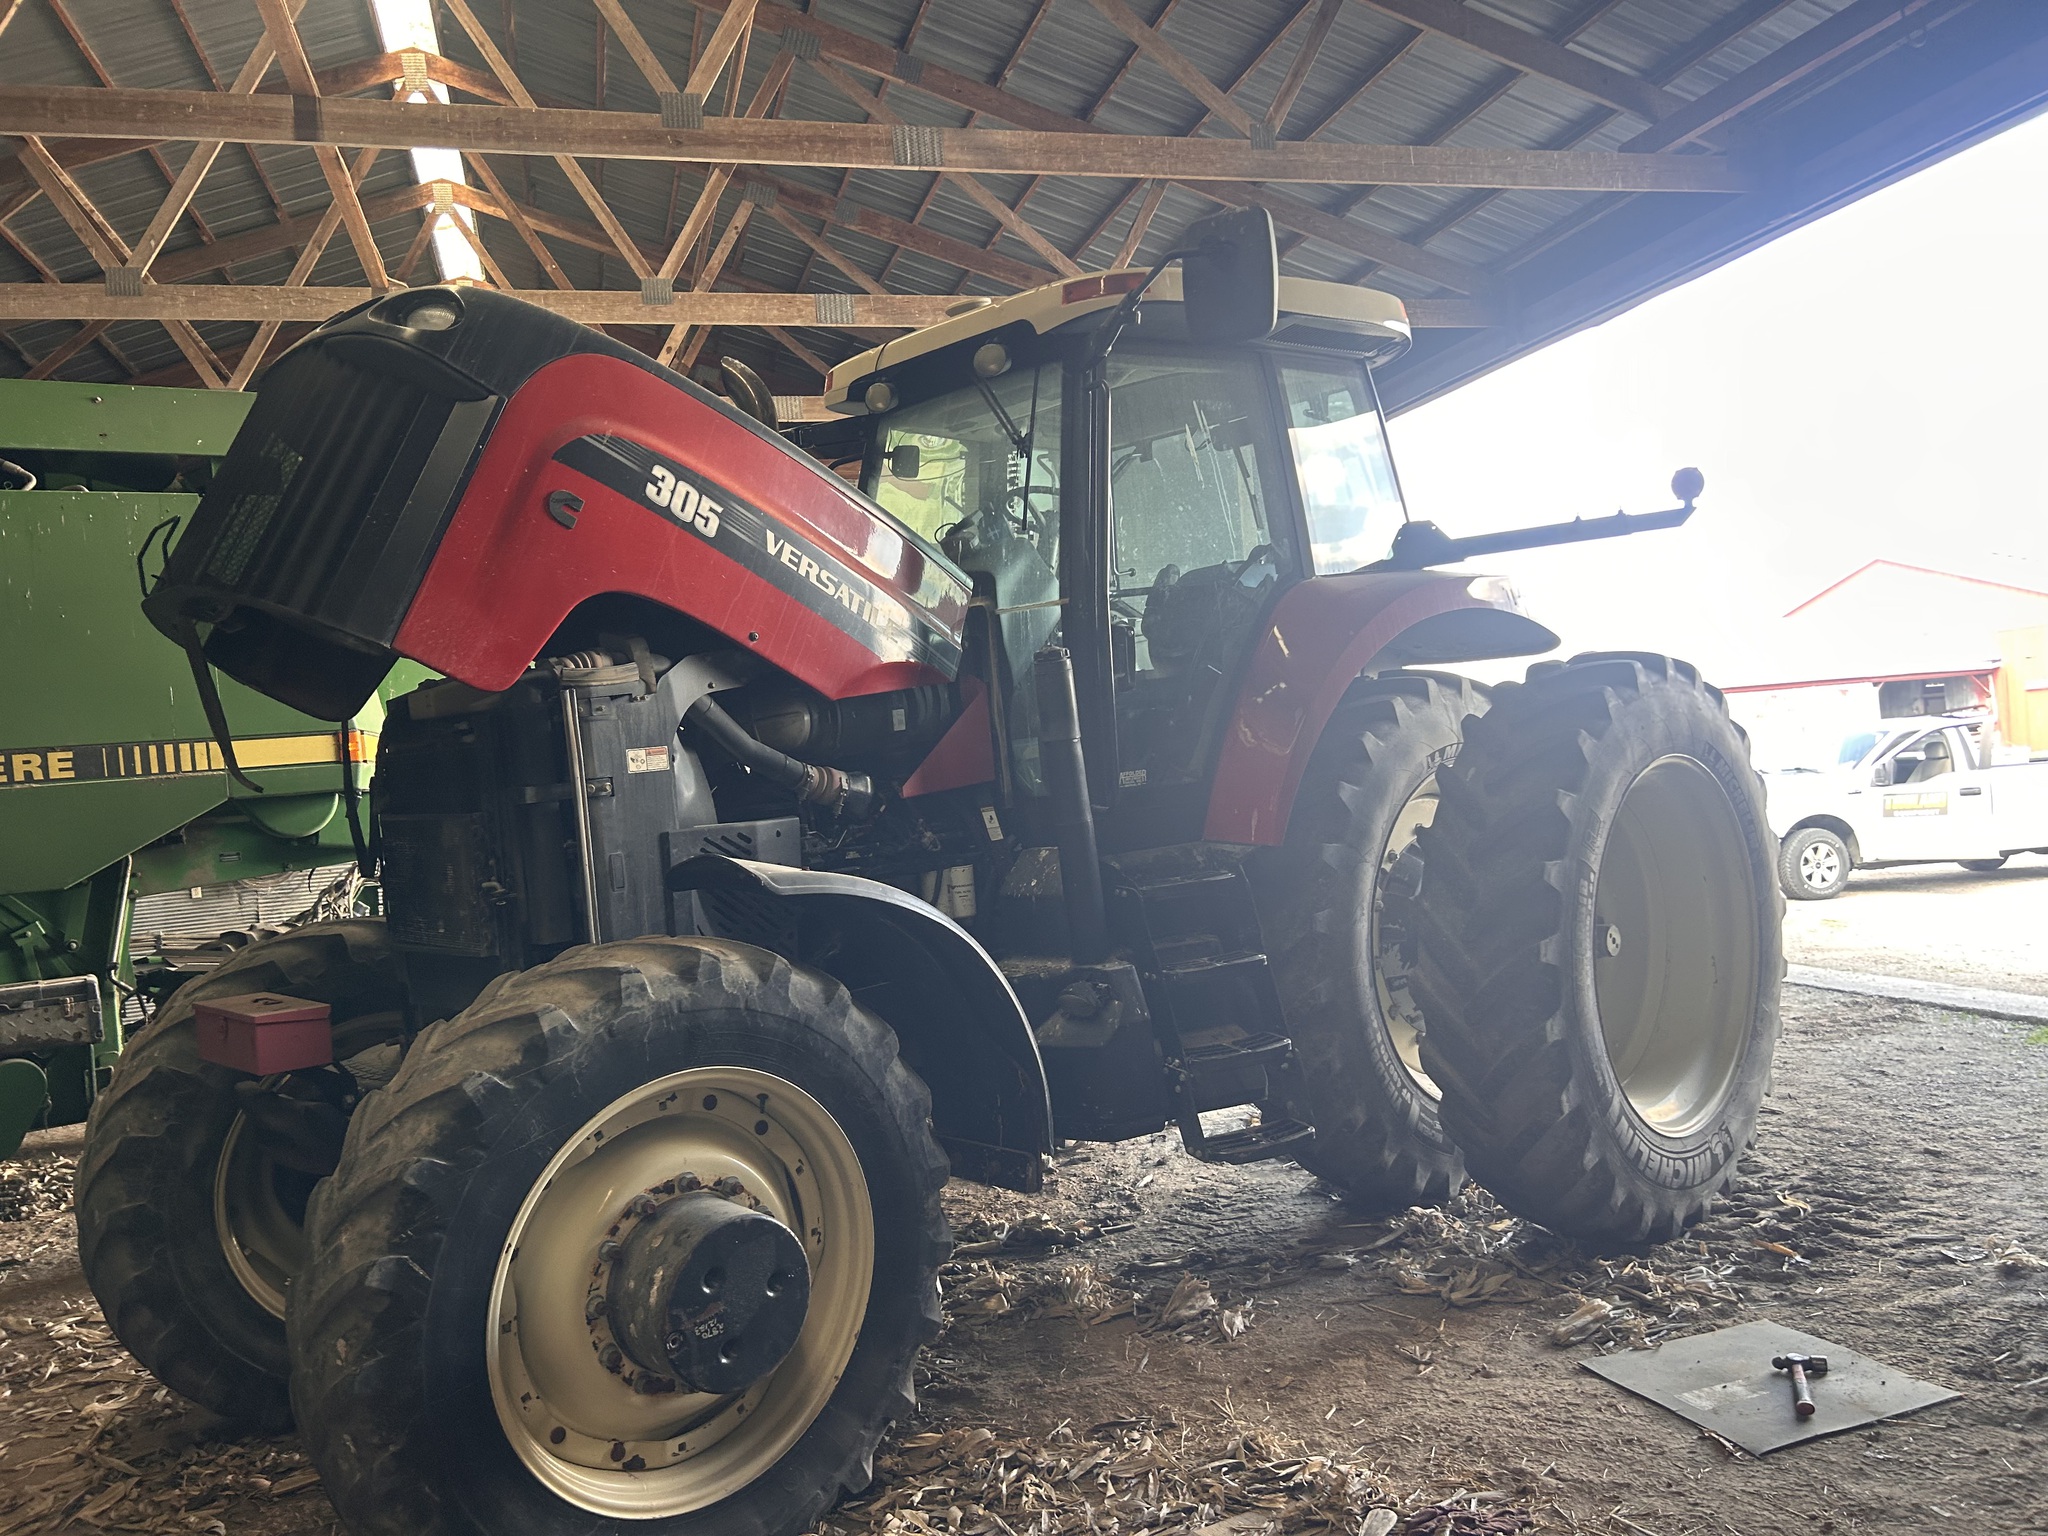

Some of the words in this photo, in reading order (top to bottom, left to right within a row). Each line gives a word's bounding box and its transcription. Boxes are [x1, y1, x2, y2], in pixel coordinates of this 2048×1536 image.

[645, 464, 725, 539] 305
[0, 751, 76, 783] RE
[1614, 1115, 1713, 1189] MICHELIN
